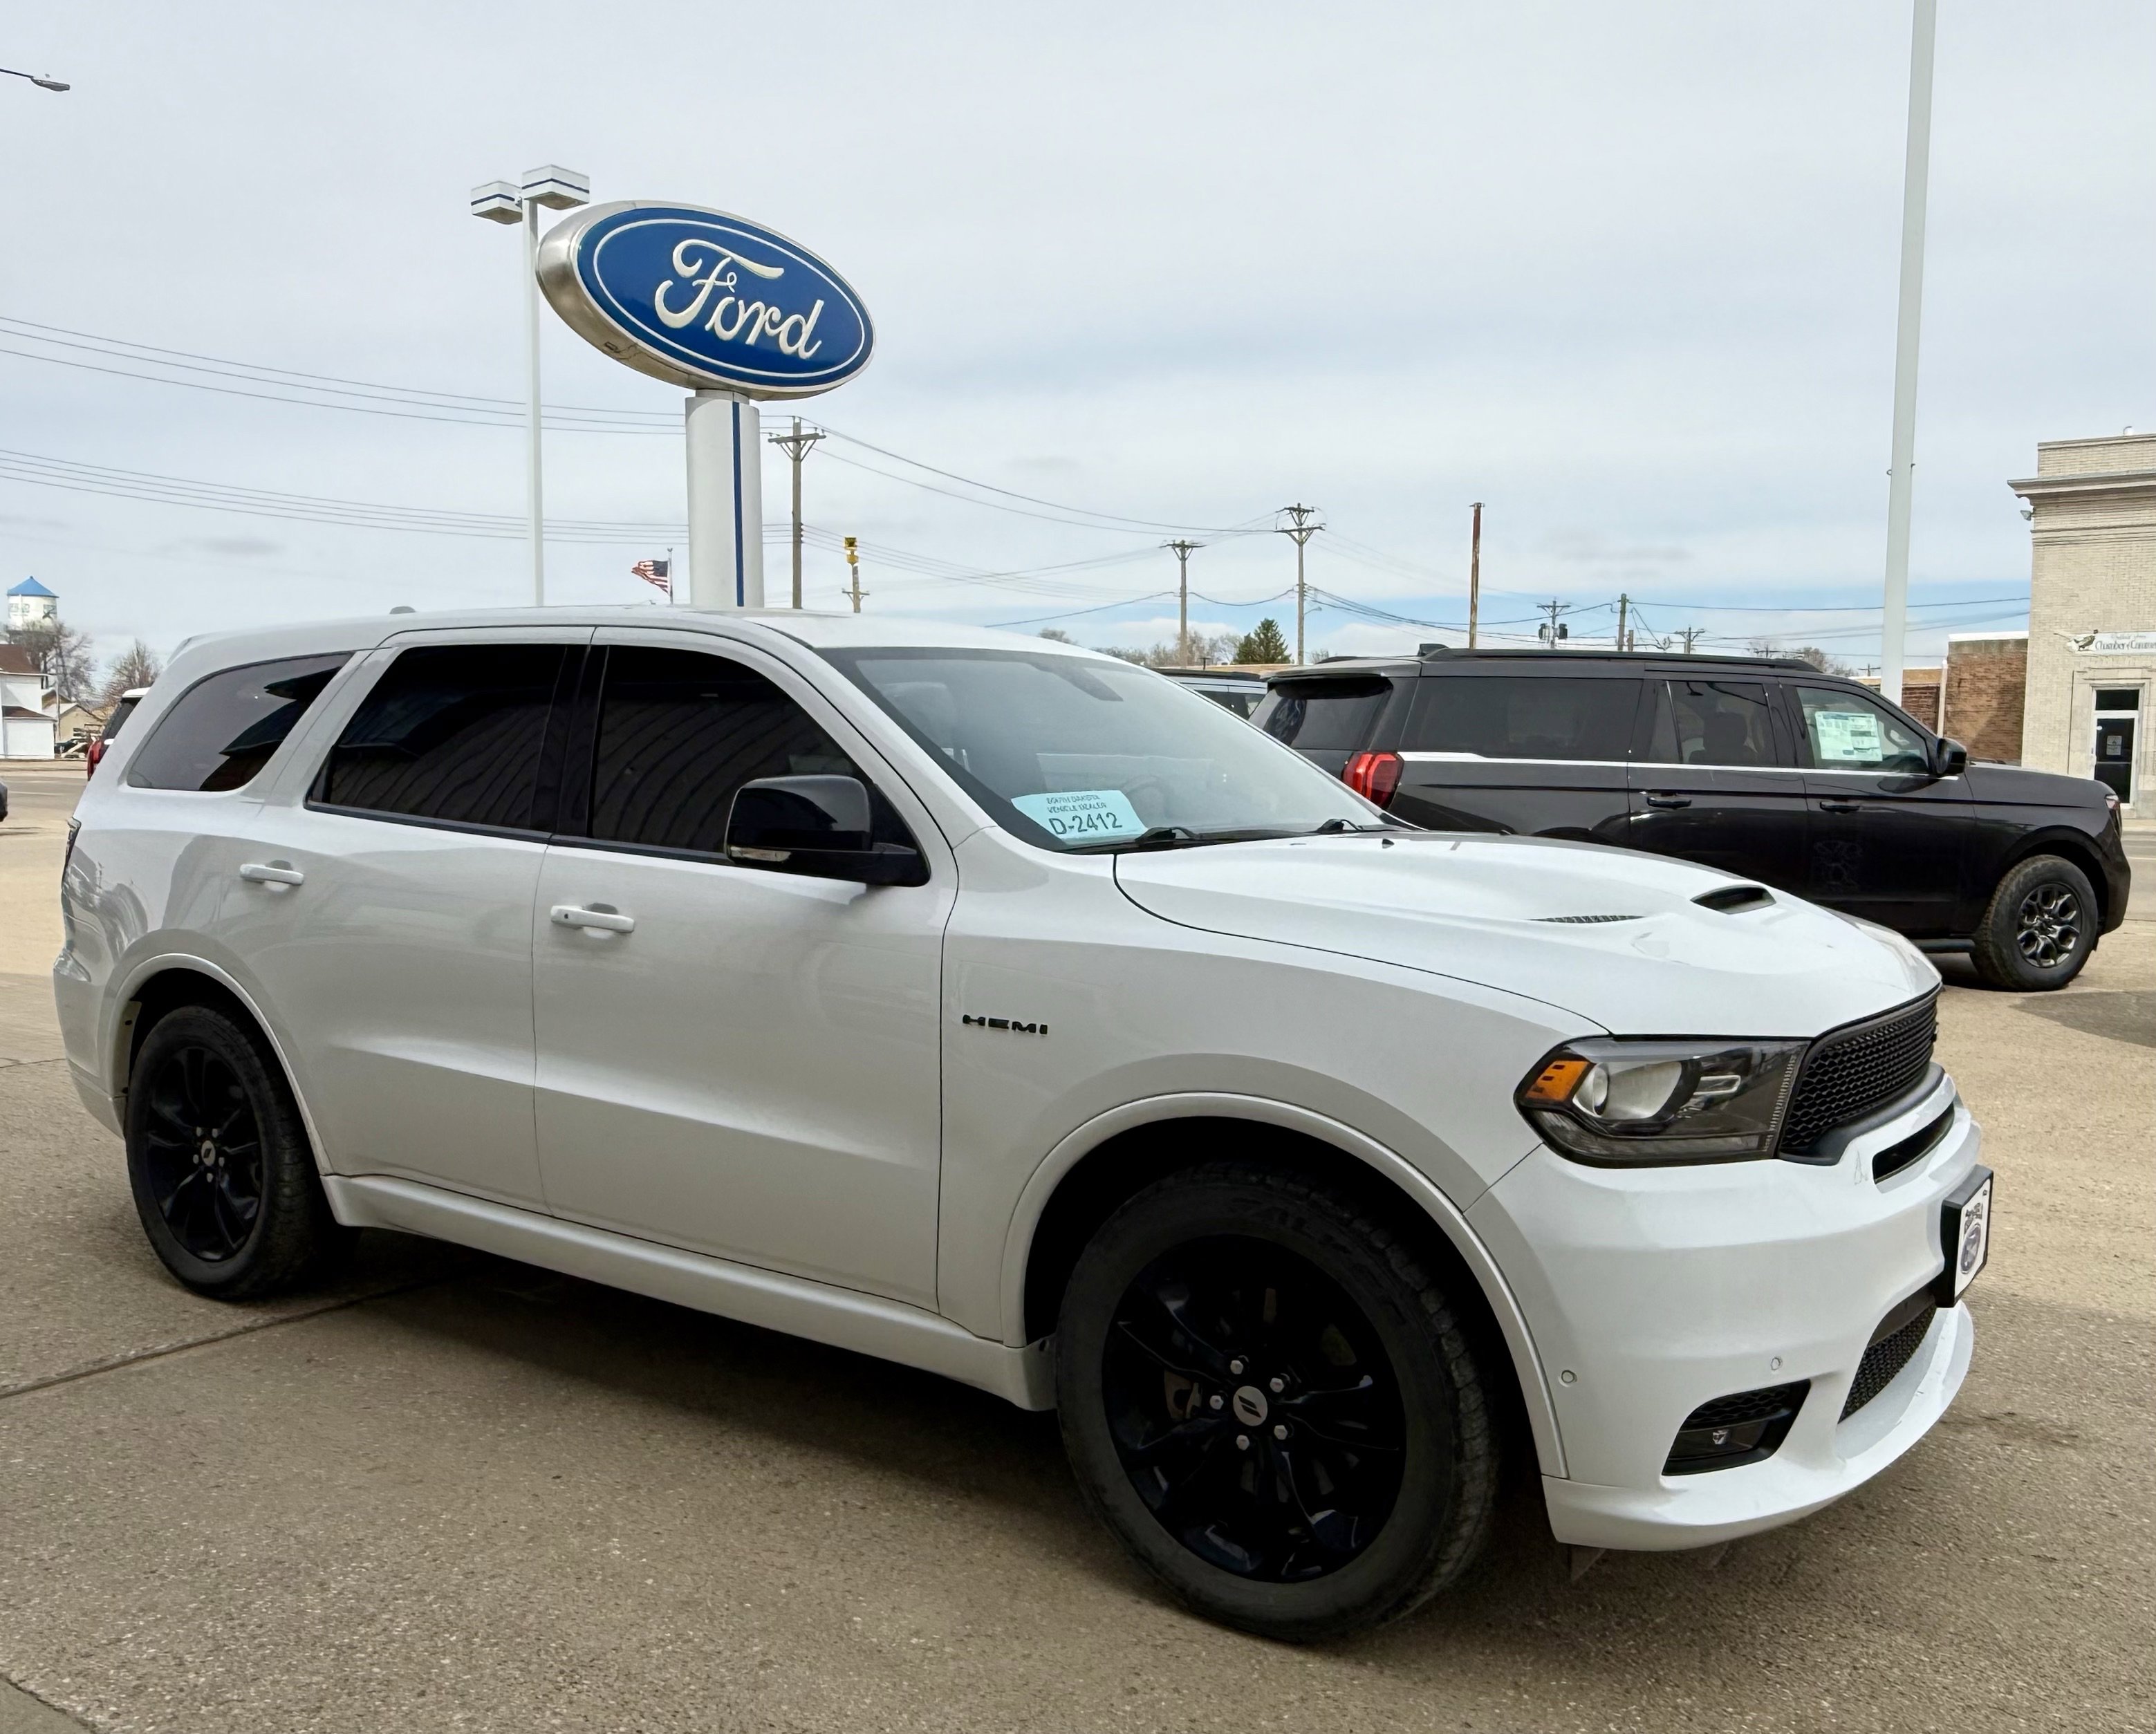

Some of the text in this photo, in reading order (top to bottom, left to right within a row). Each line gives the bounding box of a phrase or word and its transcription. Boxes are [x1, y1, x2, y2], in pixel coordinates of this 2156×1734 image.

[654, 239, 824, 360] Ford
[1048, 812, 1122, 835] D-2412
[963, 1014, 1048, 1034] HEMI
